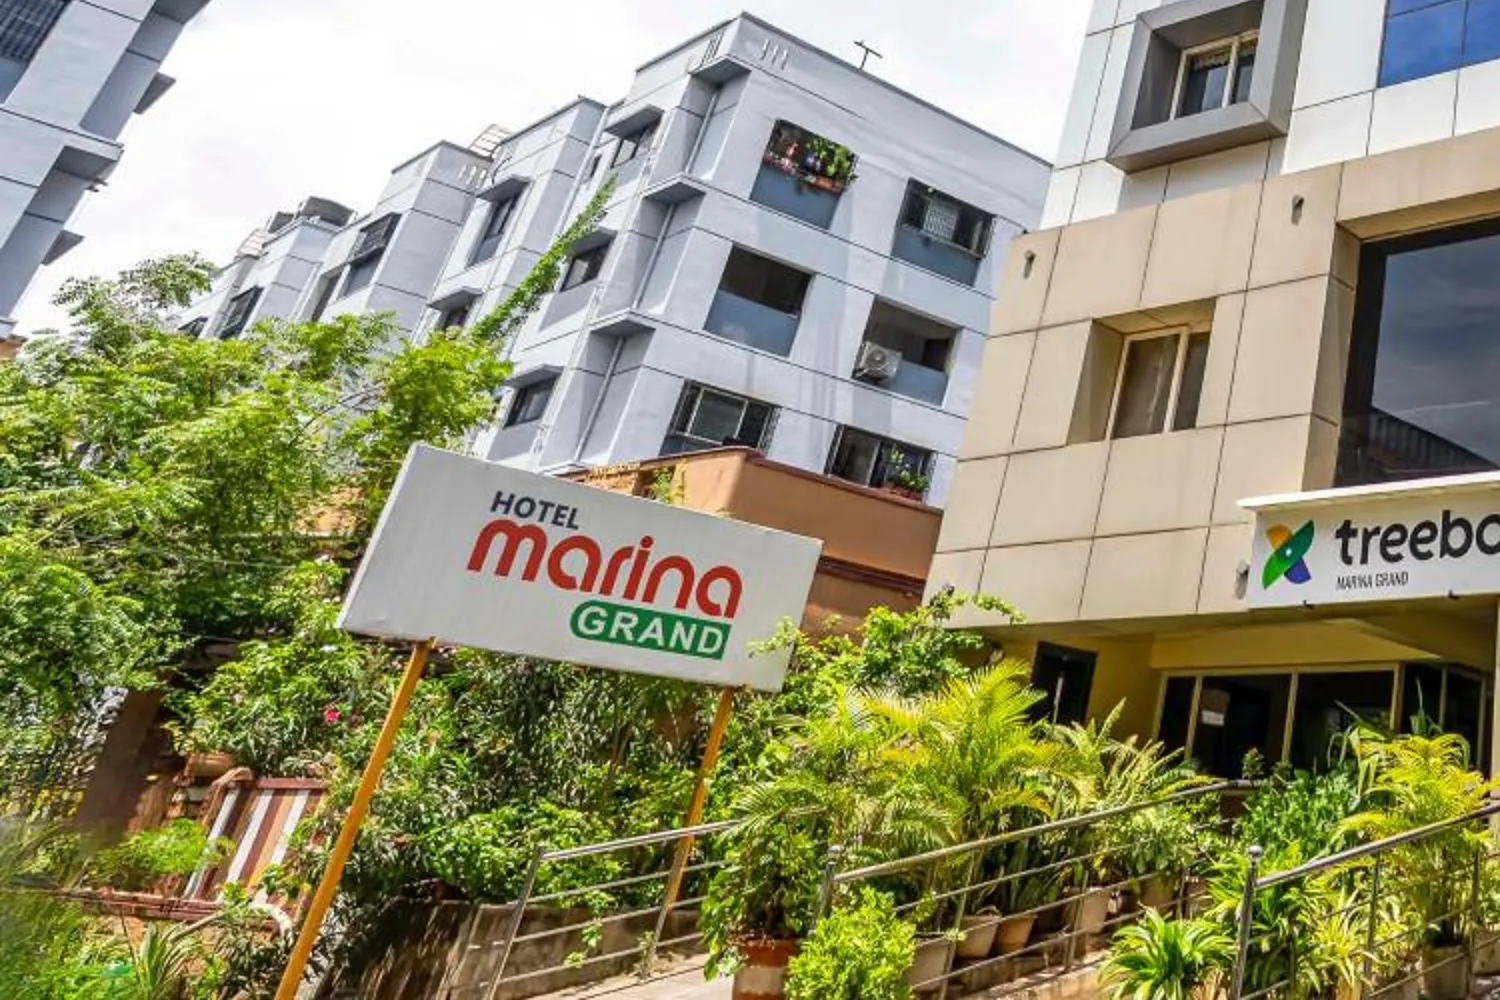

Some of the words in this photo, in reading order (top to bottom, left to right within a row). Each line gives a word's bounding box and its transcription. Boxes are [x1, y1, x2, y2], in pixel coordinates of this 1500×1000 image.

[490, 490, 579, 530] HOTEL
[466, 519, 743, 619] marina
[1336, 575, 1373, 590] MARINA
[1375, 571, 1409, 587] GRAND
[576, 606, 726, 658] GRAND
